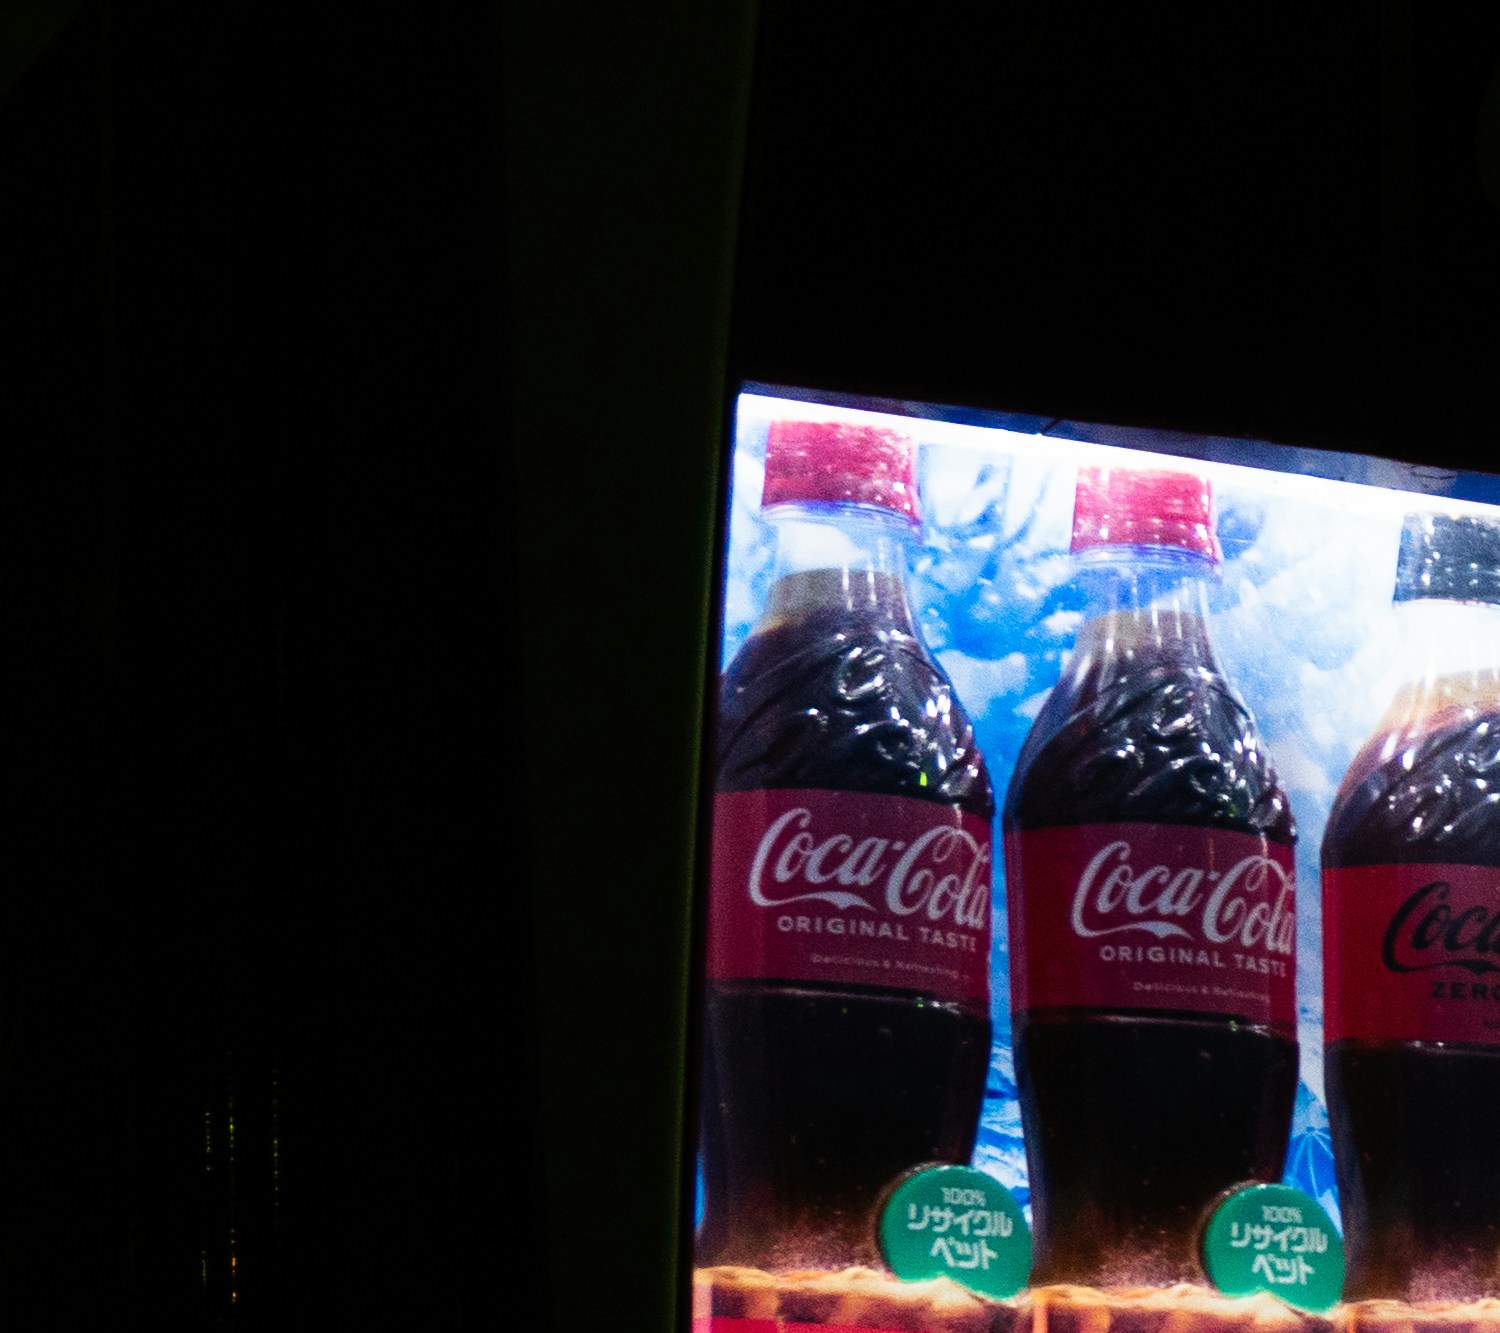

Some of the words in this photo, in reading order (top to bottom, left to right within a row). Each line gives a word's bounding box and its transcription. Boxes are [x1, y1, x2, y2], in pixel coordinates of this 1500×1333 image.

[907, 1203, 1012, 1238] リサイクル
[1230, 1221, 1327, 1253] リサイクル
[930, 1237, 997, 1272] ペット
